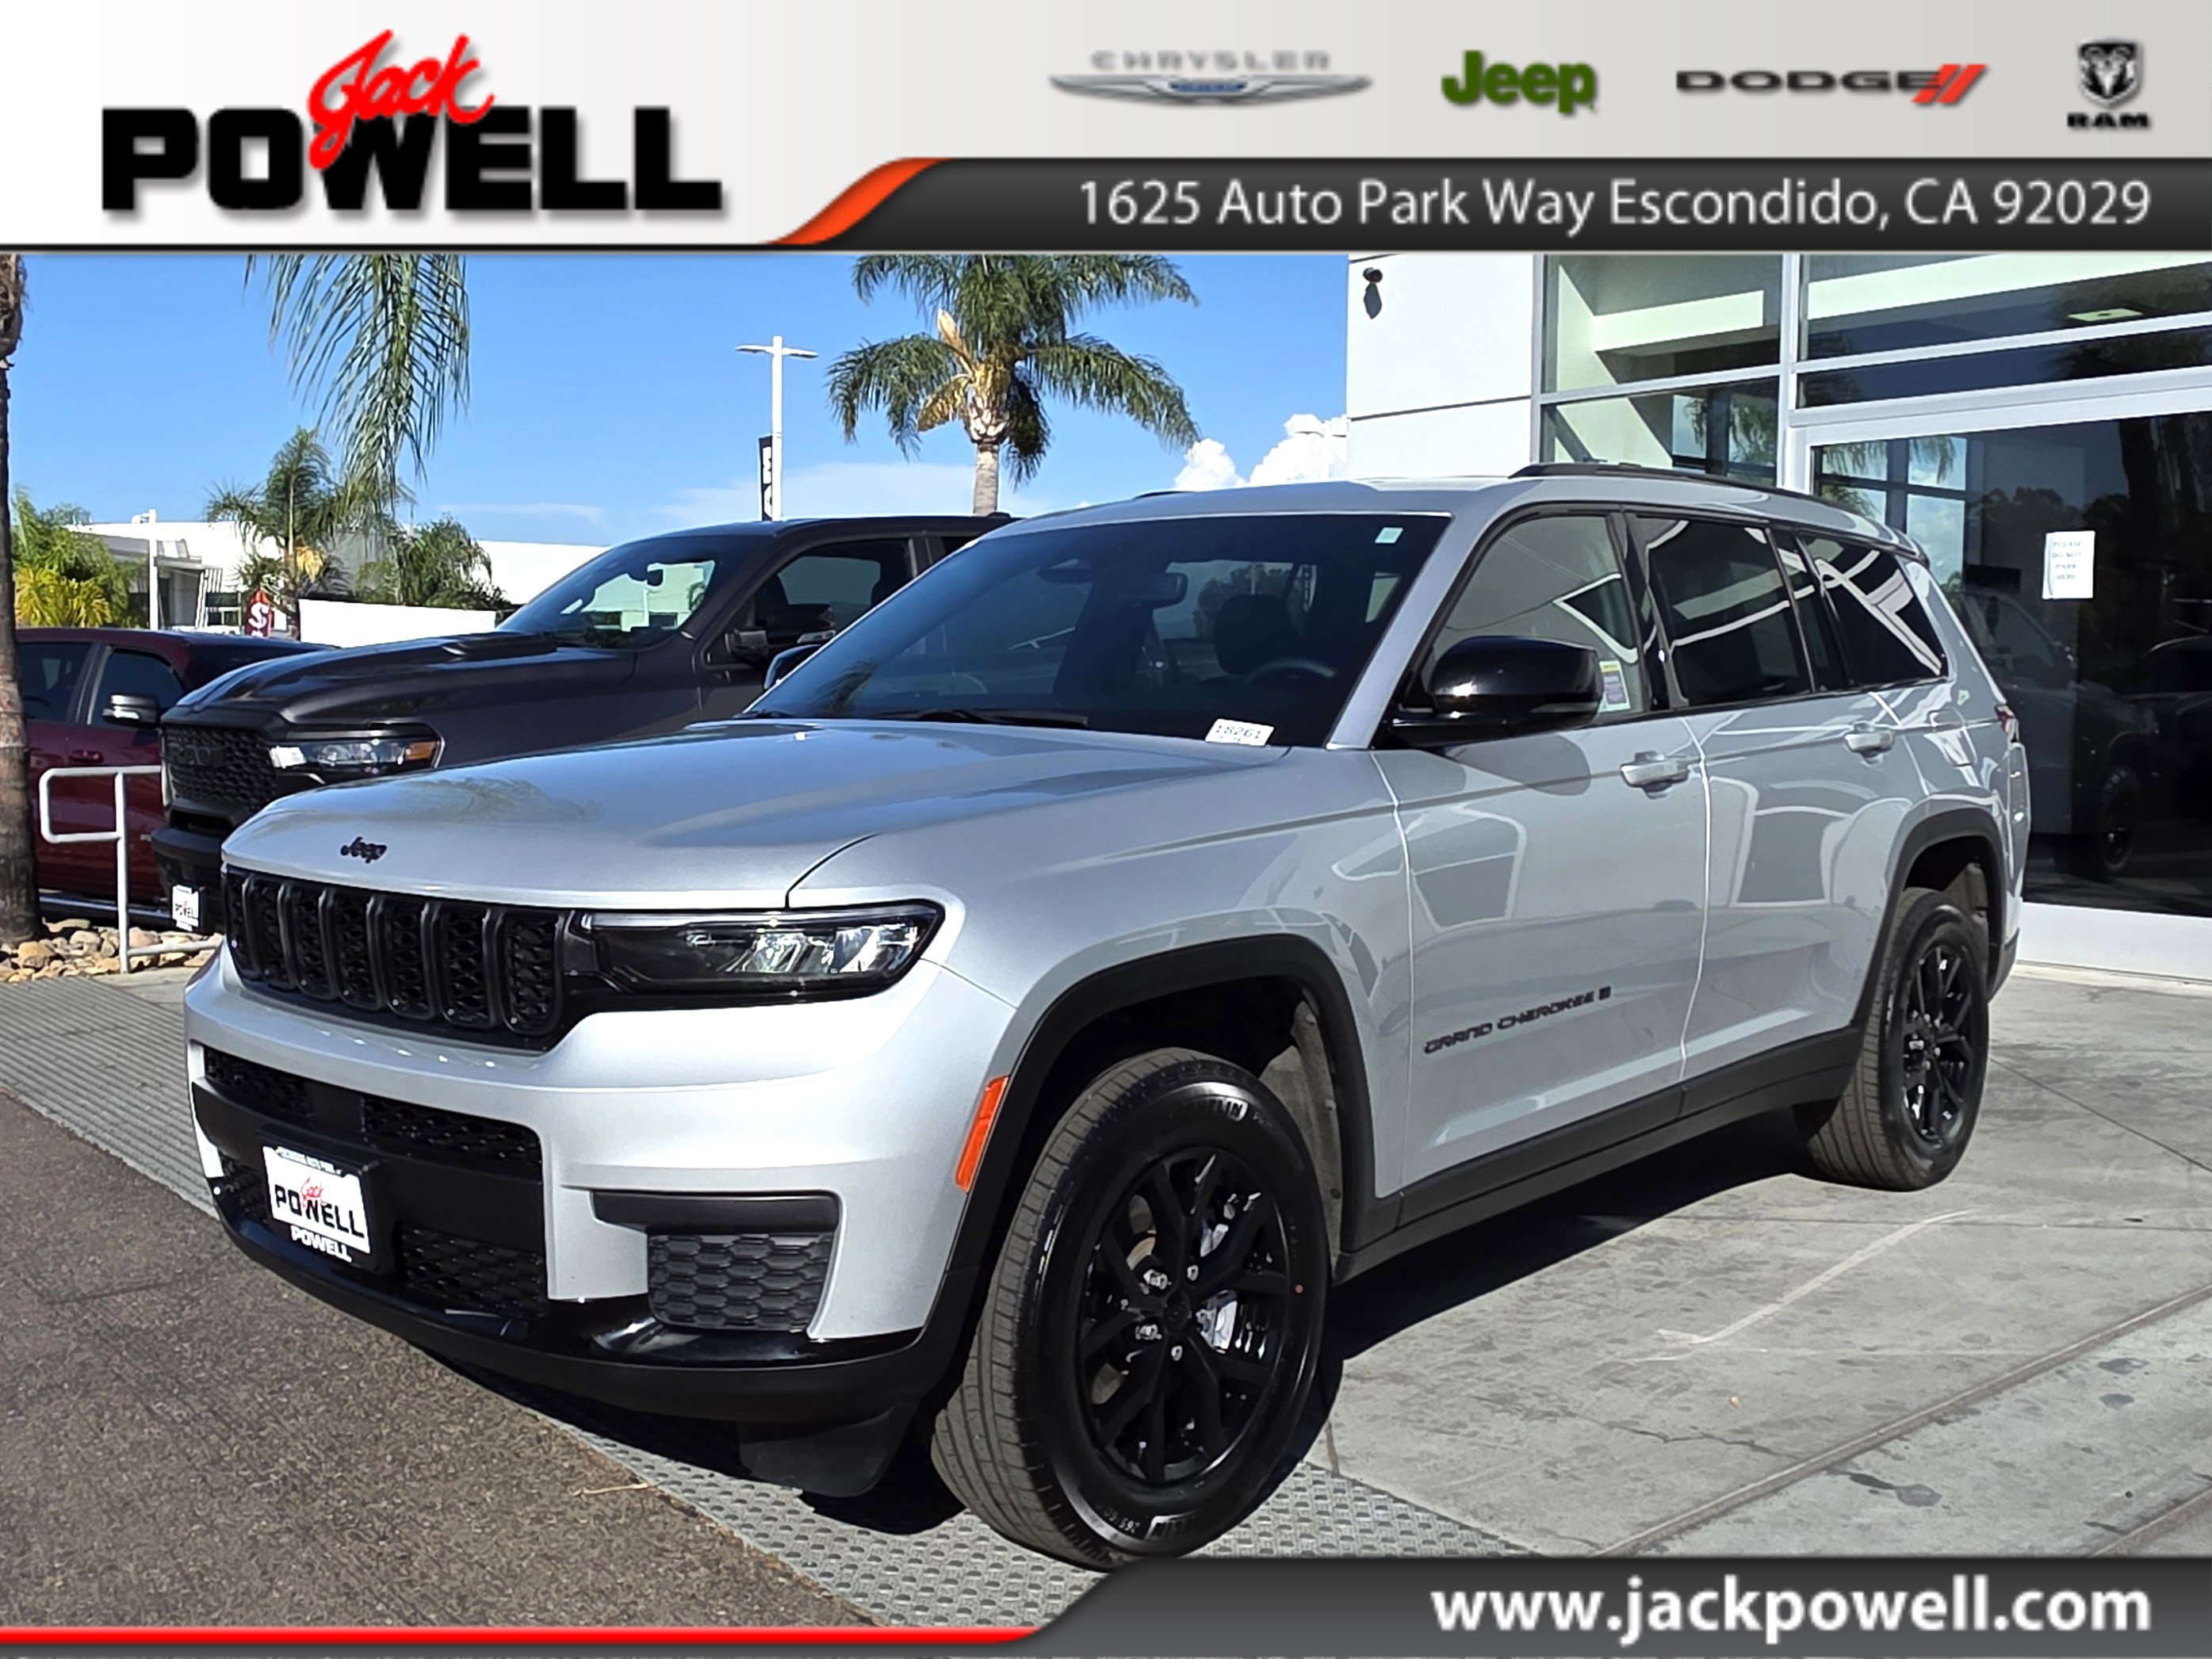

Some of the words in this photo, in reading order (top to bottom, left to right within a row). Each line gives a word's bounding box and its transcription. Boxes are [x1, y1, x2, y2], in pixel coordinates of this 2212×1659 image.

[340, 836, 387, 864] Jeep
[1424, 1023, 1493, 1054] GRAND
[1497, 991, 1595, 1030] CHEROKEE
[274, 1183, 365, 1239] POWELL
[290, 1225, 353, 1263] POWELL
